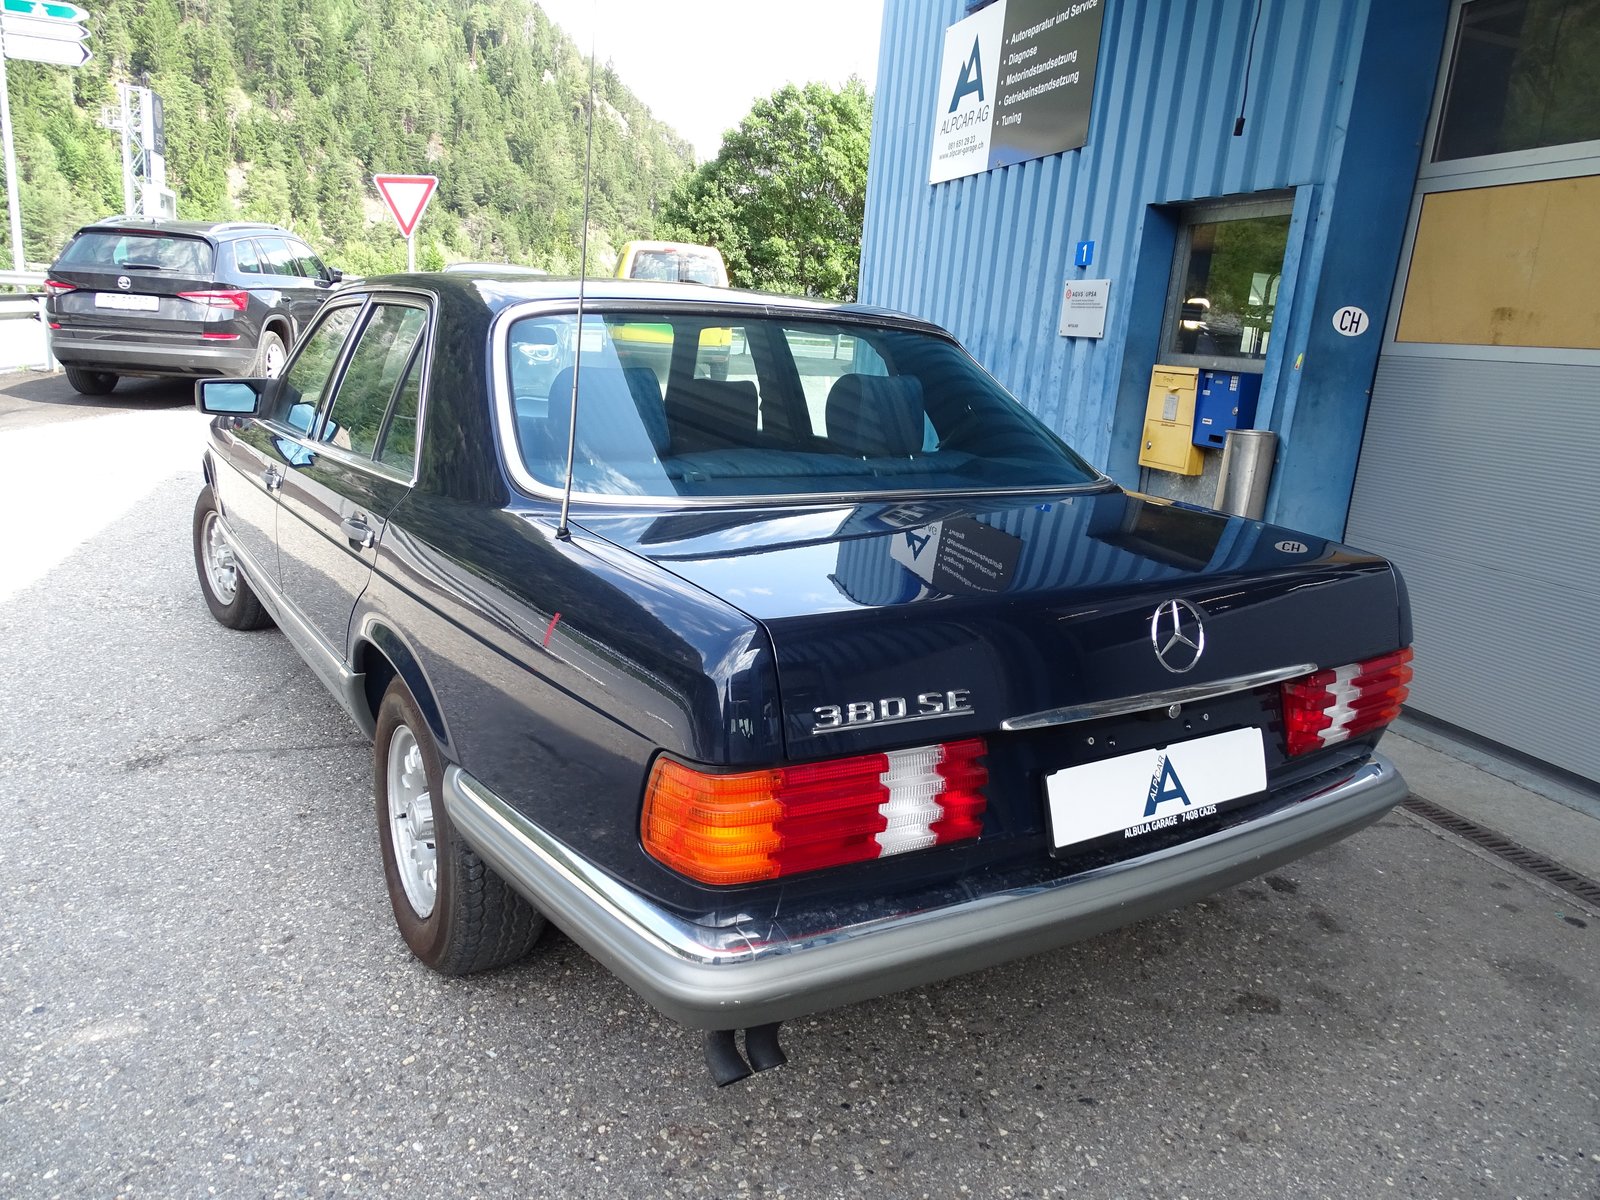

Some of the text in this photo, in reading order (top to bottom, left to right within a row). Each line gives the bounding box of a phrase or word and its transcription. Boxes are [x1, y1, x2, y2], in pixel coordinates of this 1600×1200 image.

[1011, 0, 1098, 44] Autoreparatur und Service
[1006, 50, 1077, 86] Motorindstandsetzung
[1008, 46, 1038, 66] Diagnose
[1003, 71, 1079, 106] Getriebeinstandsetzung
[940, 105, 989, 136] ALPCAR AG
[1002, 112, 1022, 127] Tuning
[1082, 244, 1088, 263] 1
[1339, 309, 1362, 333] CH
[812, 688, 971, 729] 380 SE
[1150, 754, 1165, 802] ALPCAR
[1124, 804, 1217, 839] ALBULA GARAGE 7408 CAZIS
